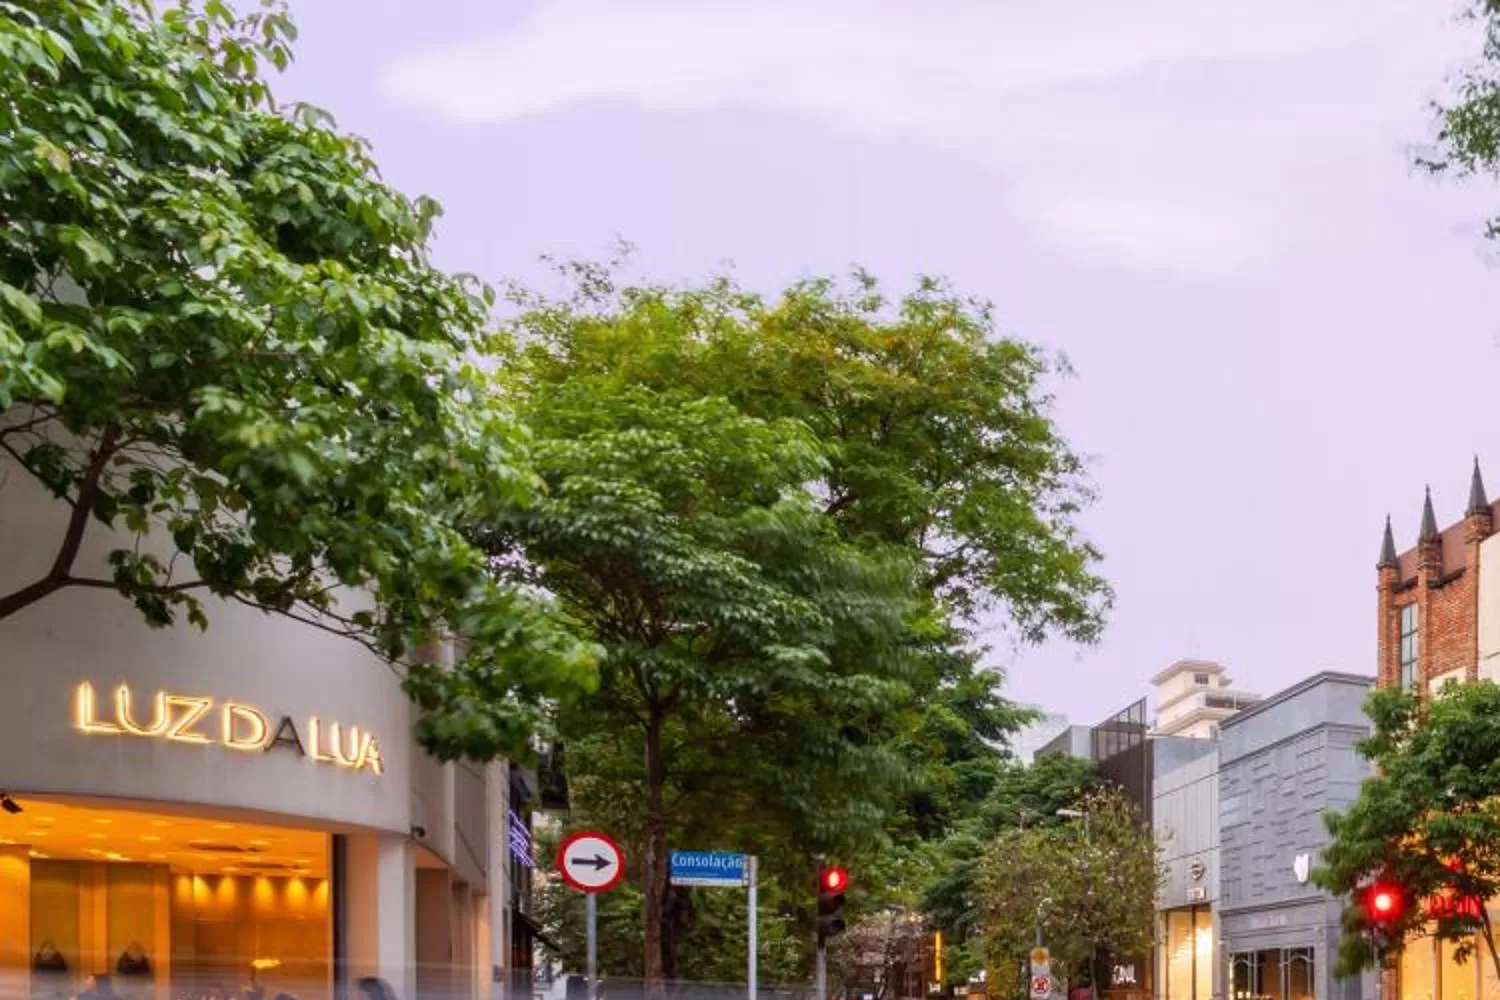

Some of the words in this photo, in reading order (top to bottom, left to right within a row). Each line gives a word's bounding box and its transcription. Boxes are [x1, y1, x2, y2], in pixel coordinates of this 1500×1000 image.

[74, 680, 215, 743] LUZ
[221, 700, 306, 756] DA
[308, 716, 384, 775] LUA
[671, 853, 743, 871] Consolação
